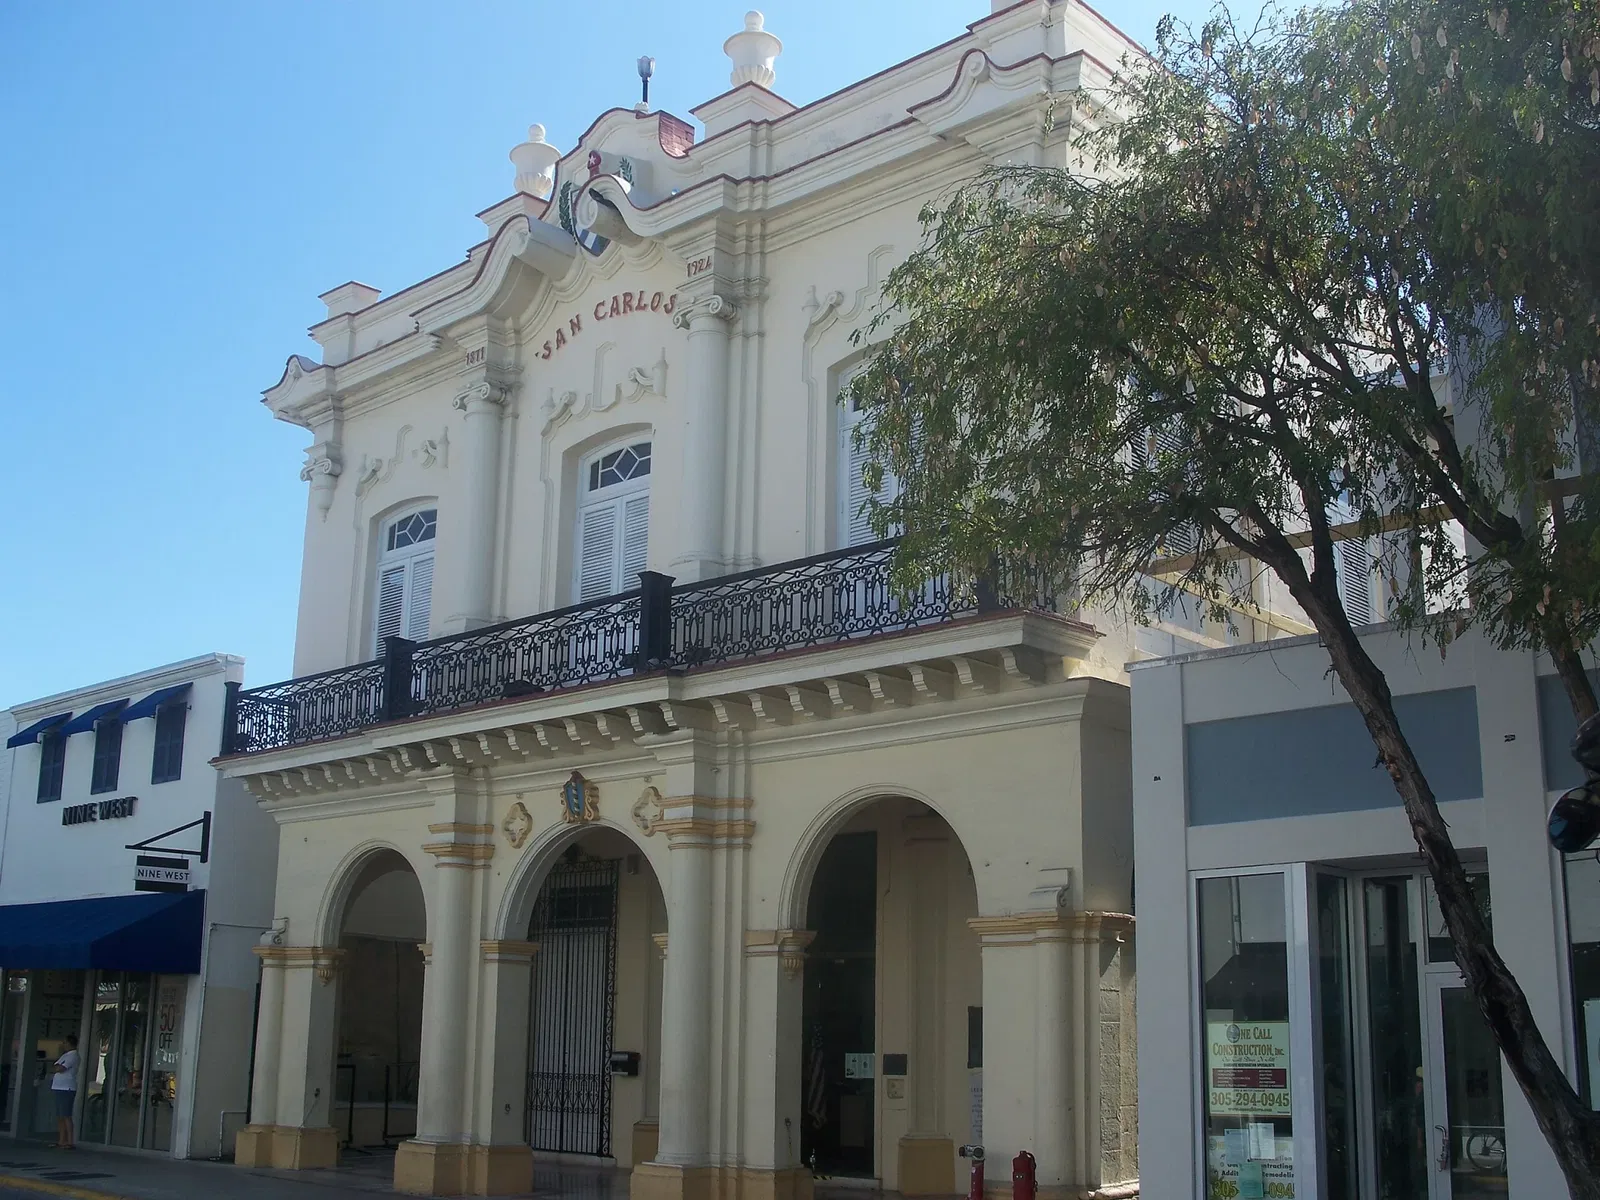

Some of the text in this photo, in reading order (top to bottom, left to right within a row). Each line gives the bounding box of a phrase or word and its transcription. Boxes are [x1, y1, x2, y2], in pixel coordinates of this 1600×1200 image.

[686, 256, 711, 277] 1924
[541, 290, 678, 360] SAN CARLOS
[62, 796, 138, 826] NINE WEST
[137, 868, 190, 881] NINE WEST
[158, 1032, 174, 1050] OFF
[1211, 1092, 1290, 1107] 305-294-0945
